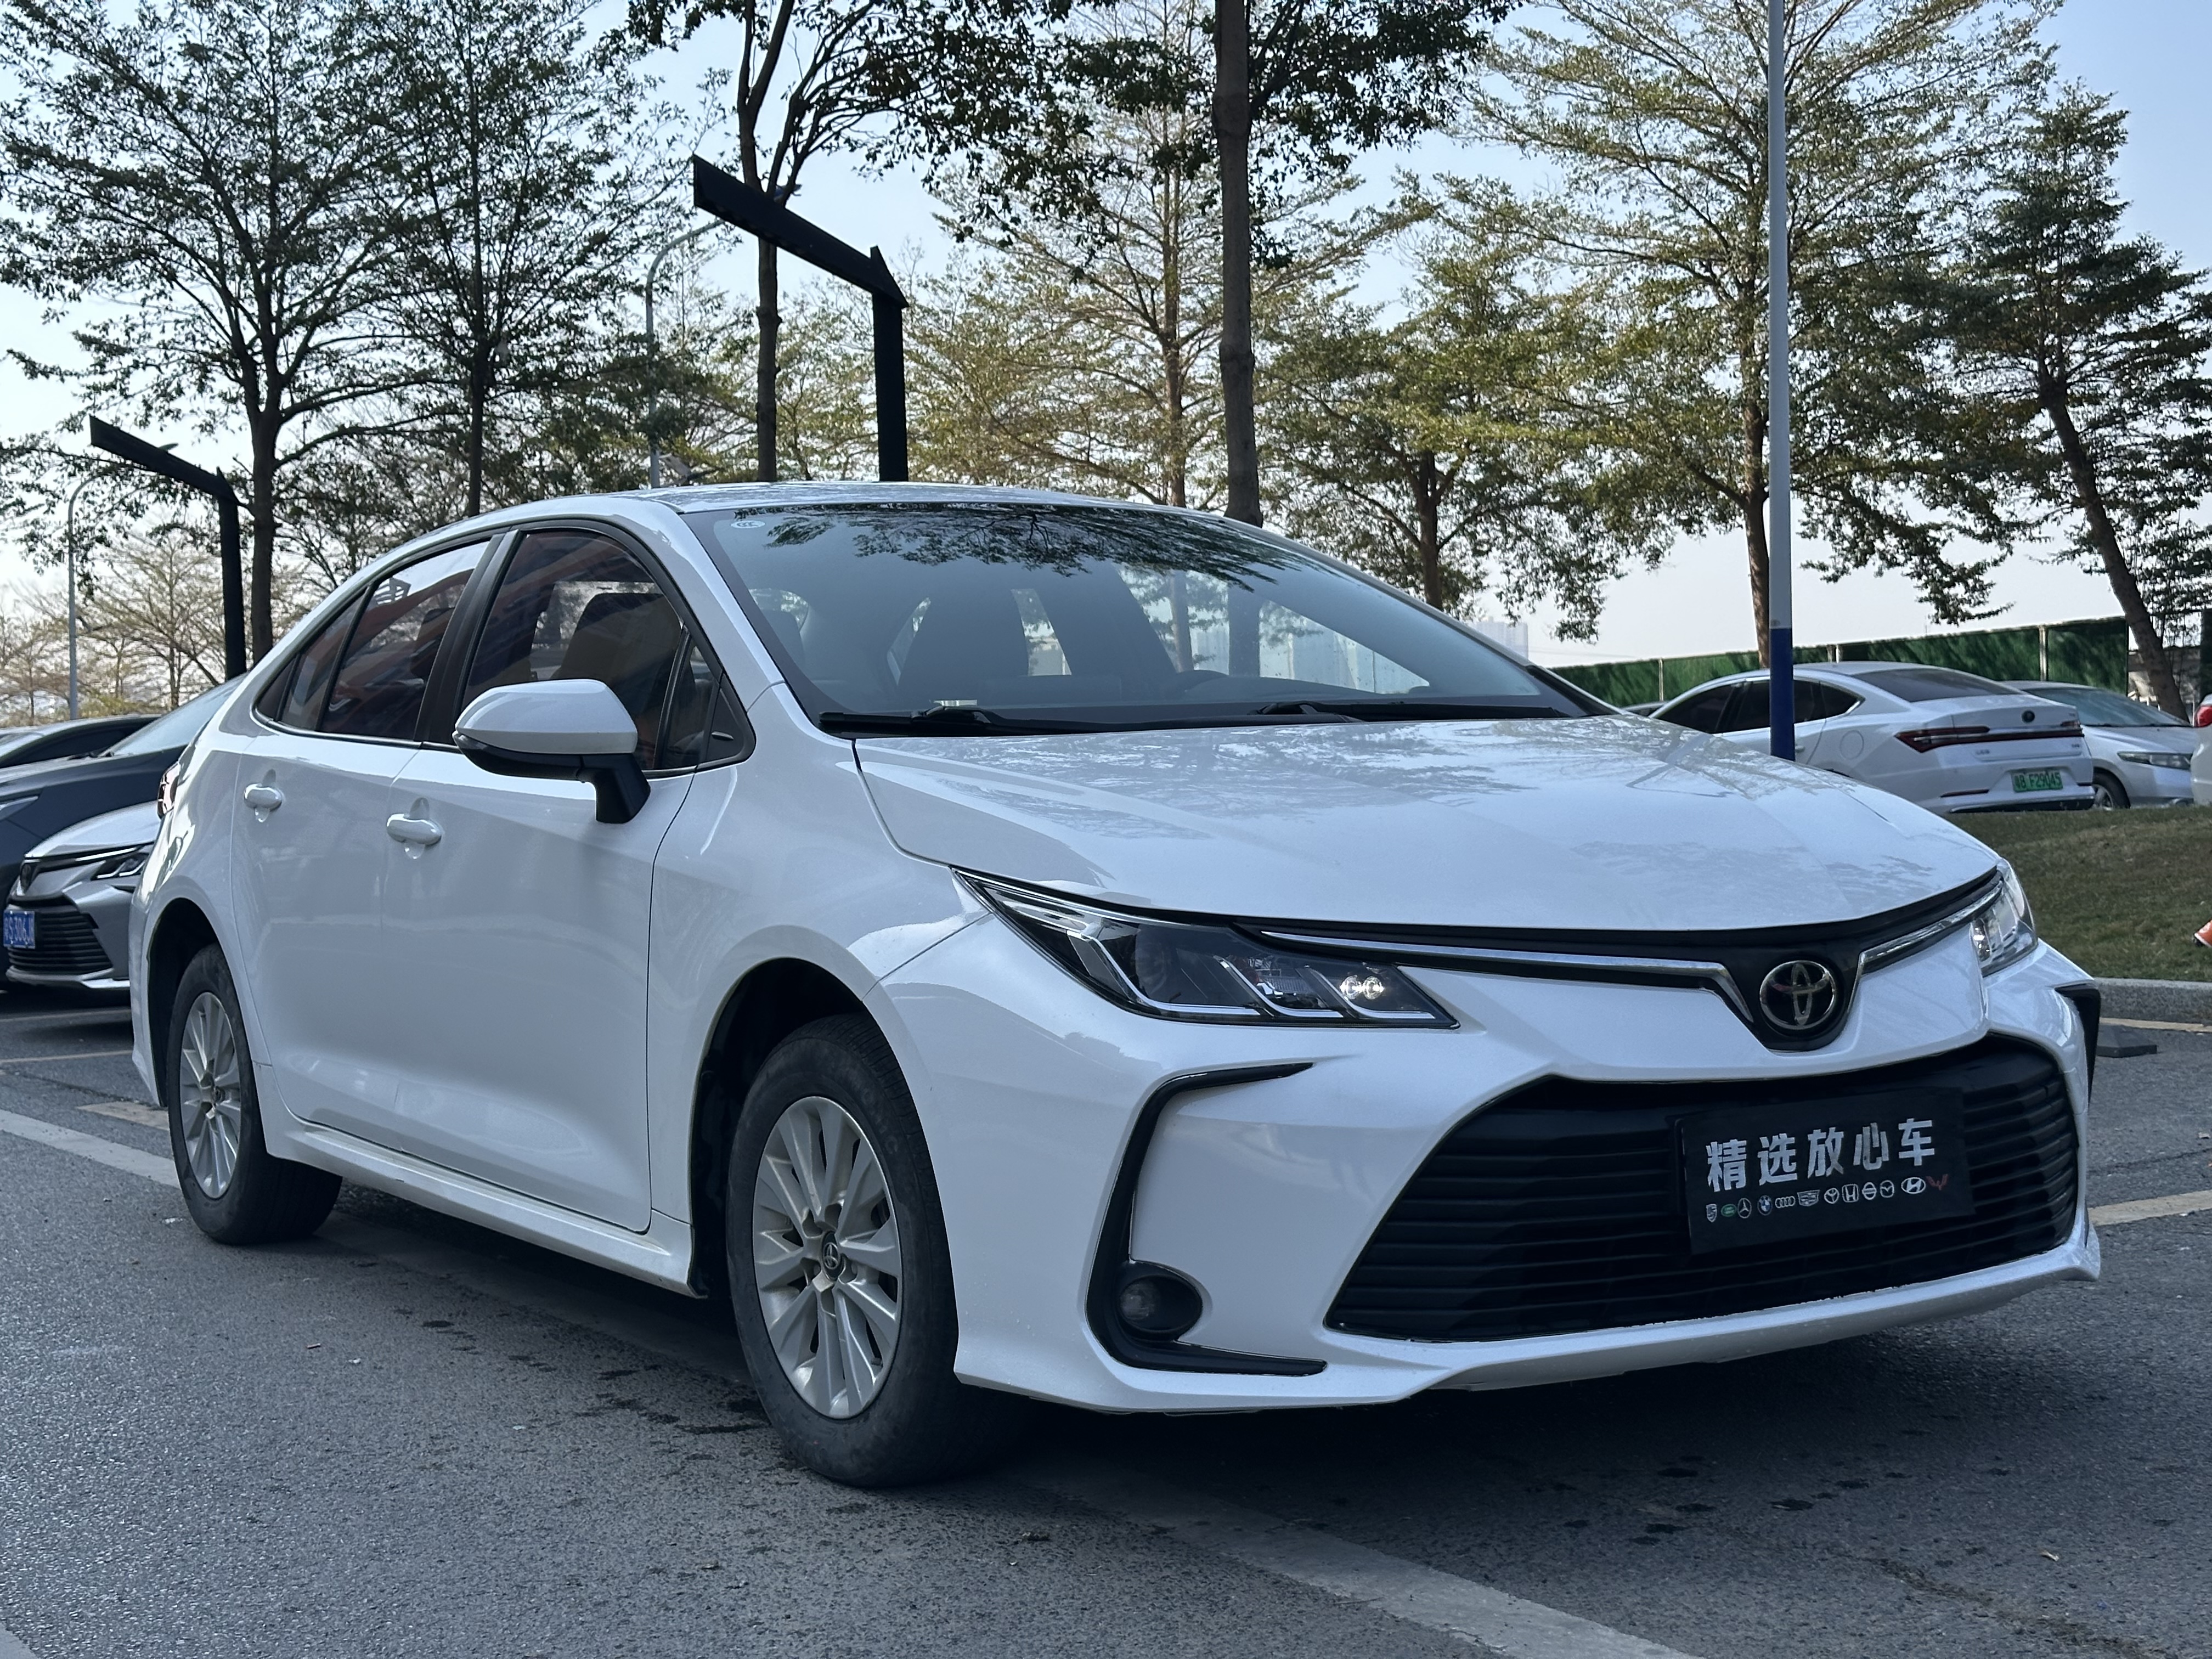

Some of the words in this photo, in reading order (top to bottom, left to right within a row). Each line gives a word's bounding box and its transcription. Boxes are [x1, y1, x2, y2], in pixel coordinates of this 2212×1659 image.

[1706, 1118, 1935, 1192] 精选放心车
